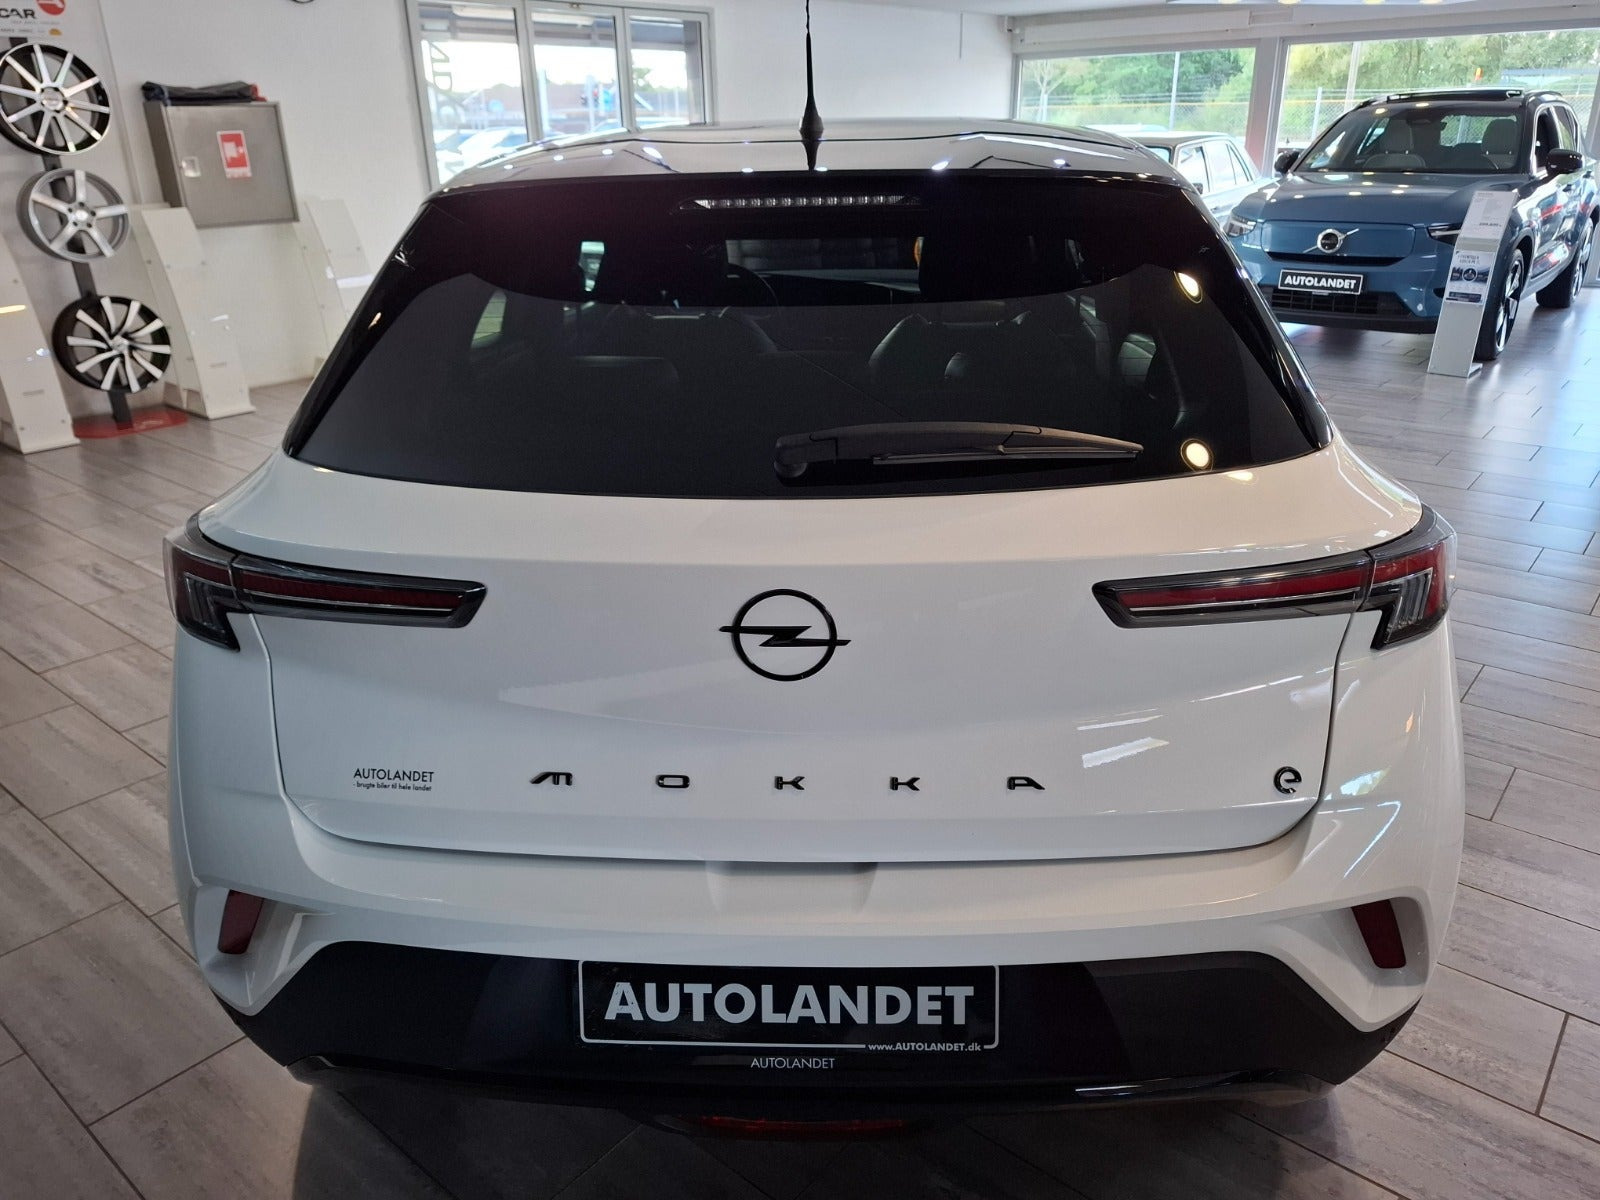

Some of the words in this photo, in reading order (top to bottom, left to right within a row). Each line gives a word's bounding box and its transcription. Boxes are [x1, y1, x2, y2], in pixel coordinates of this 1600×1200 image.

[1284, 275, 1357, 289] AUTOLANDET
[353, 768, 434, 782] AUTOLANDET
[530, 771, 1045, 792] MOKKA
[357, 781, 375, 790] brugte
[604, 982, 975, 1025] AUTOLANDET
[868, 1042, 982, 1052] www.AUTOLANDET.dk
[750, 1057, 836, 1069] AUTOLANDET
